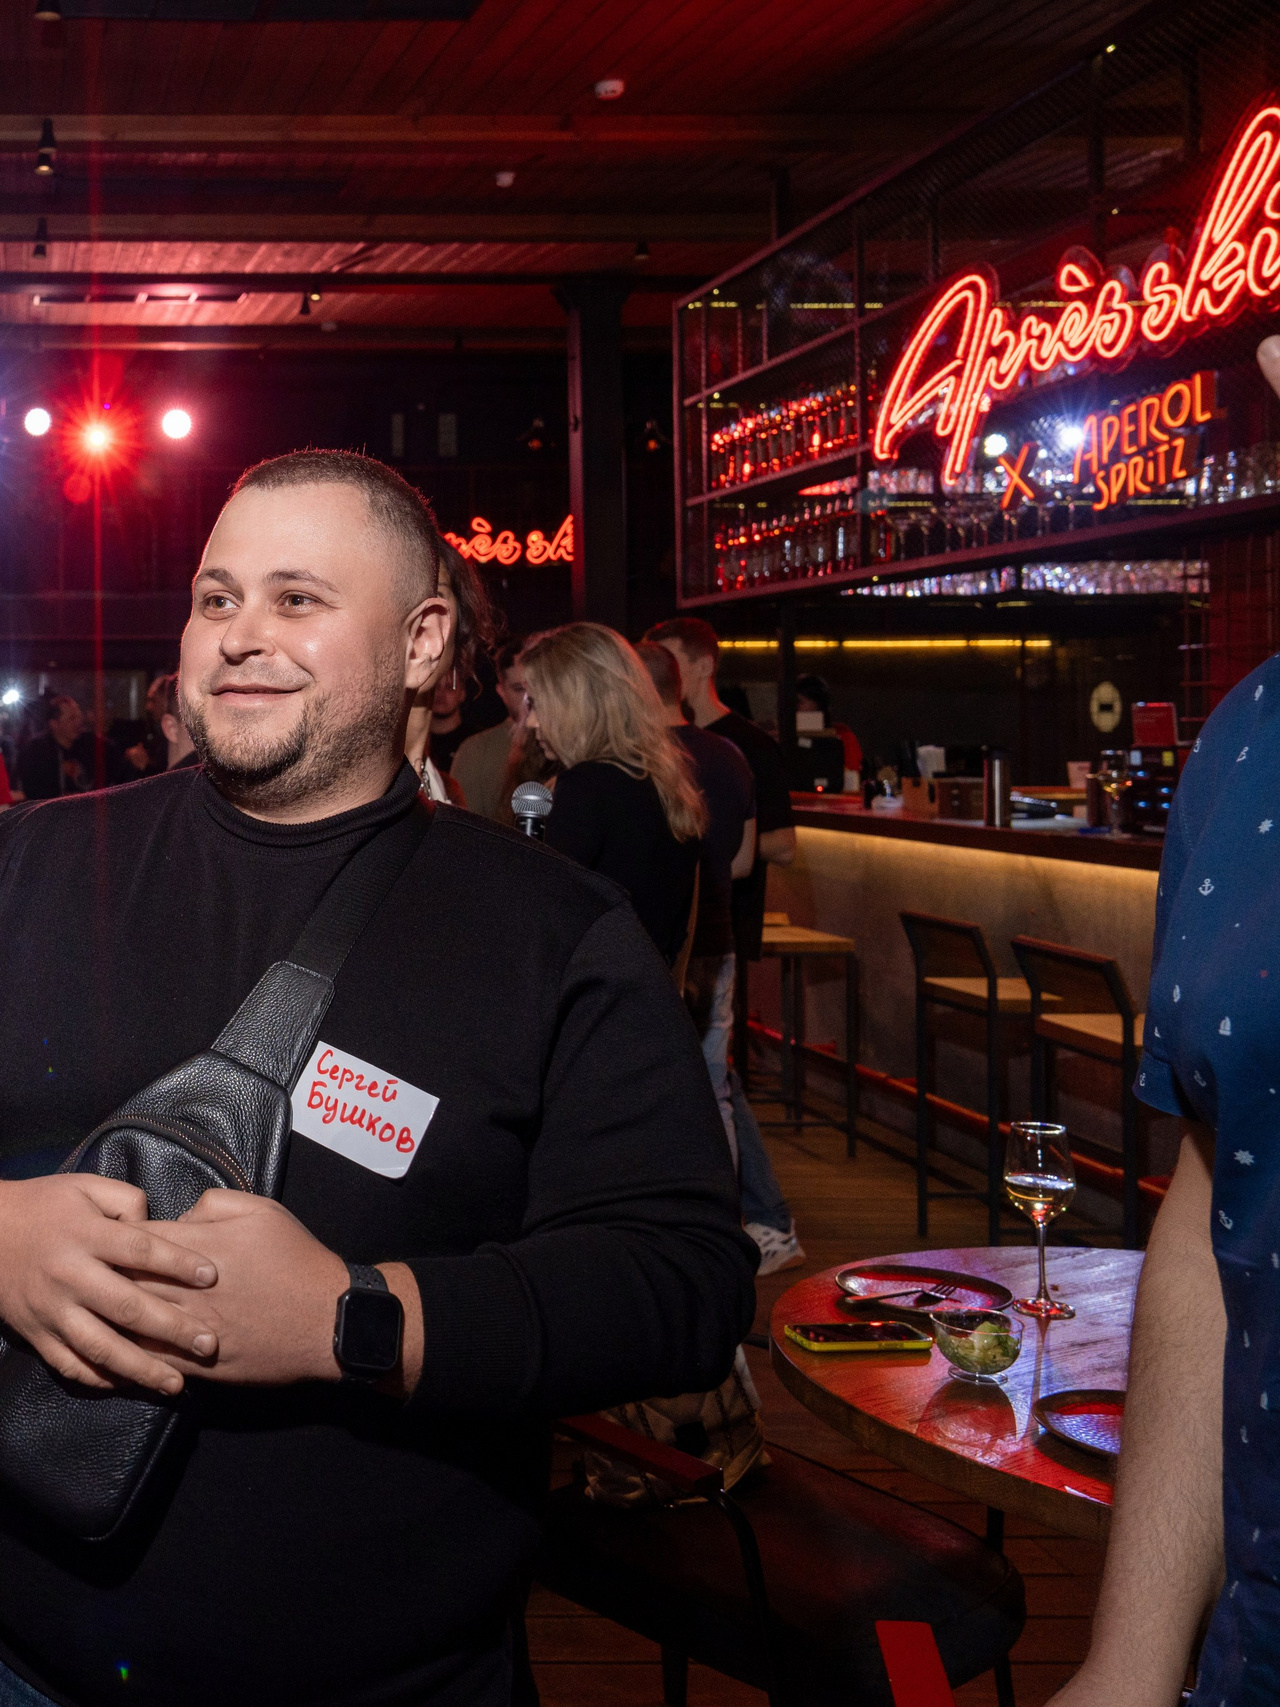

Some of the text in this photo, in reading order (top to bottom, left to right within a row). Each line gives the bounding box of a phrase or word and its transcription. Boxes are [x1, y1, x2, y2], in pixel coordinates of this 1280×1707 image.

[872, 262, 1134, 486] Après
[1072, 371, 1212, 485] APEROL
[306, 1080, 416, 1154] Бушков
[316, 1049, 399, 1103] Сергей
